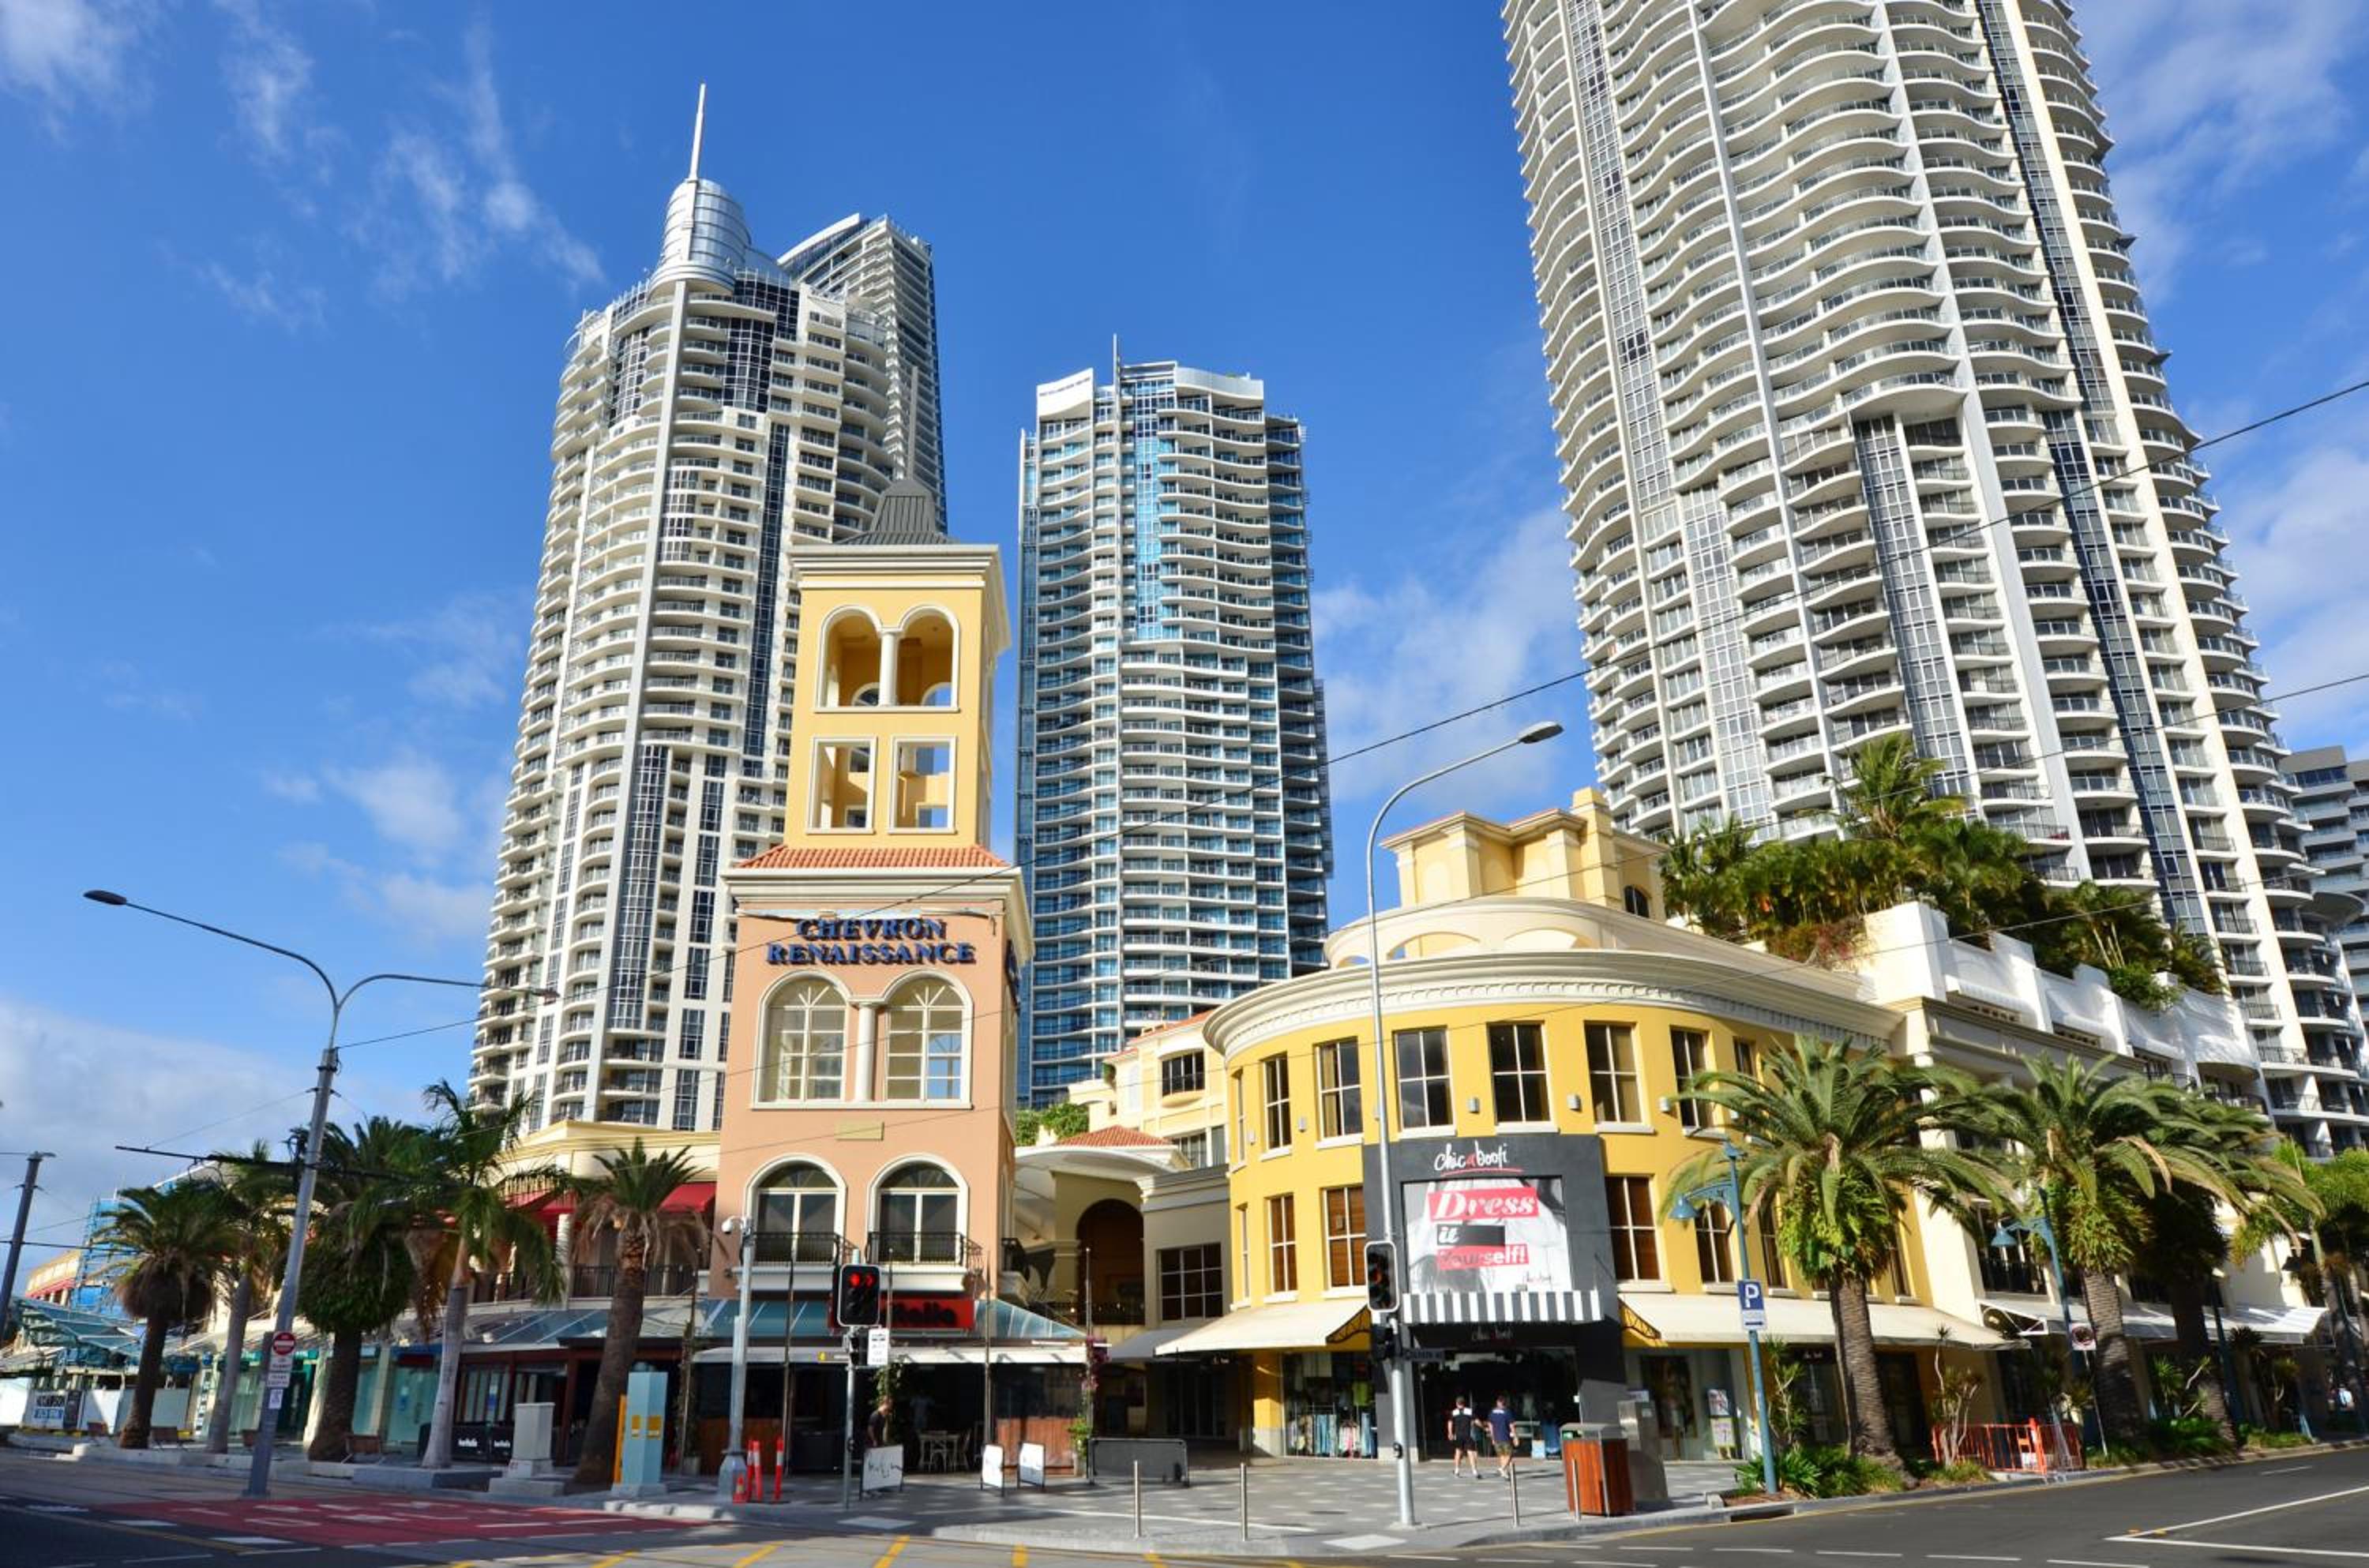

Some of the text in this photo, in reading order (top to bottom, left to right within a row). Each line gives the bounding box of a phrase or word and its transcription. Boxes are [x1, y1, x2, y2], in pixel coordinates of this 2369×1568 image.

[796, 918, 947, 940] CHEVRON
[766, 942, 977, 966] RENAISSANCE
[1432, 1193, 1535, 1219] Dress
[1437, 1225, 1460, 1244] it
[1744, 1283, 1760, 1308] P
